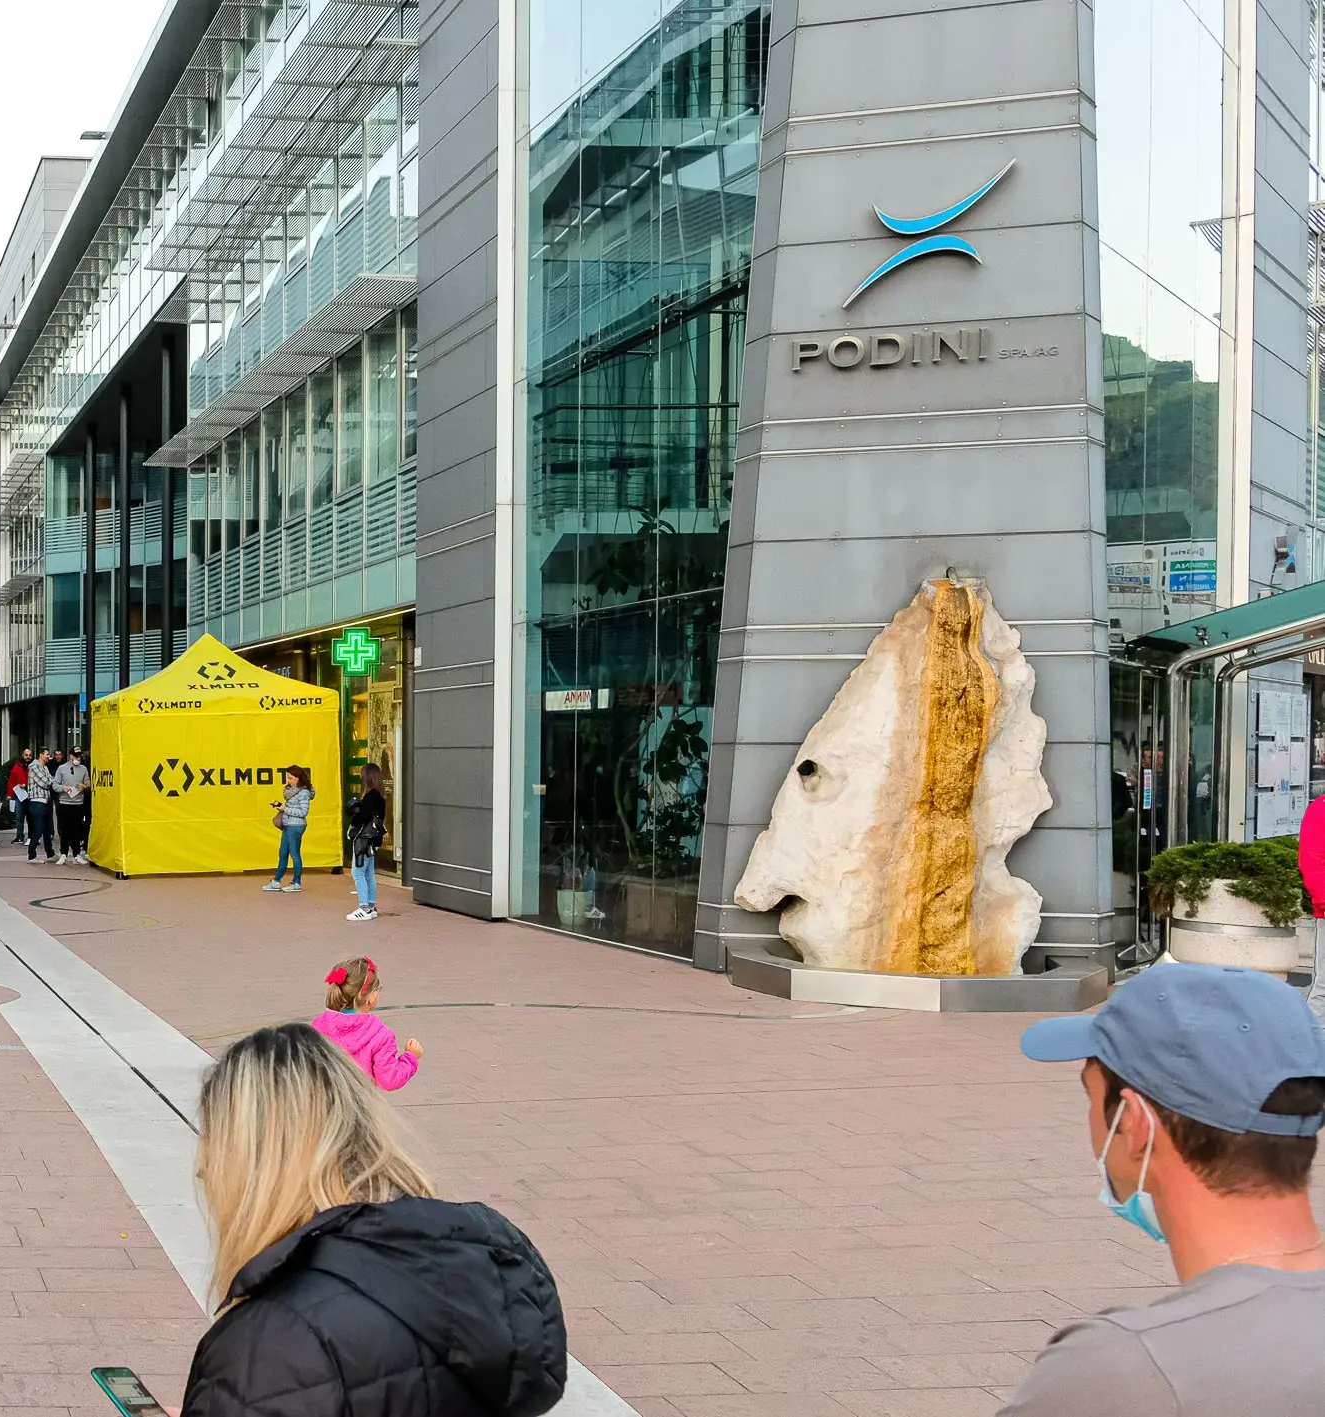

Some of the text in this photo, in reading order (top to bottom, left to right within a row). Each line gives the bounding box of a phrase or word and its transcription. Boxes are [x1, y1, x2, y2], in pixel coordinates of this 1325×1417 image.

[791, 327, 989, 371] PODINI
[188, 682, 260, 690] XLMOTO
[157, 700, 202, 709] XLMOTO
[278, 697, 322, 706] XLMOTO
